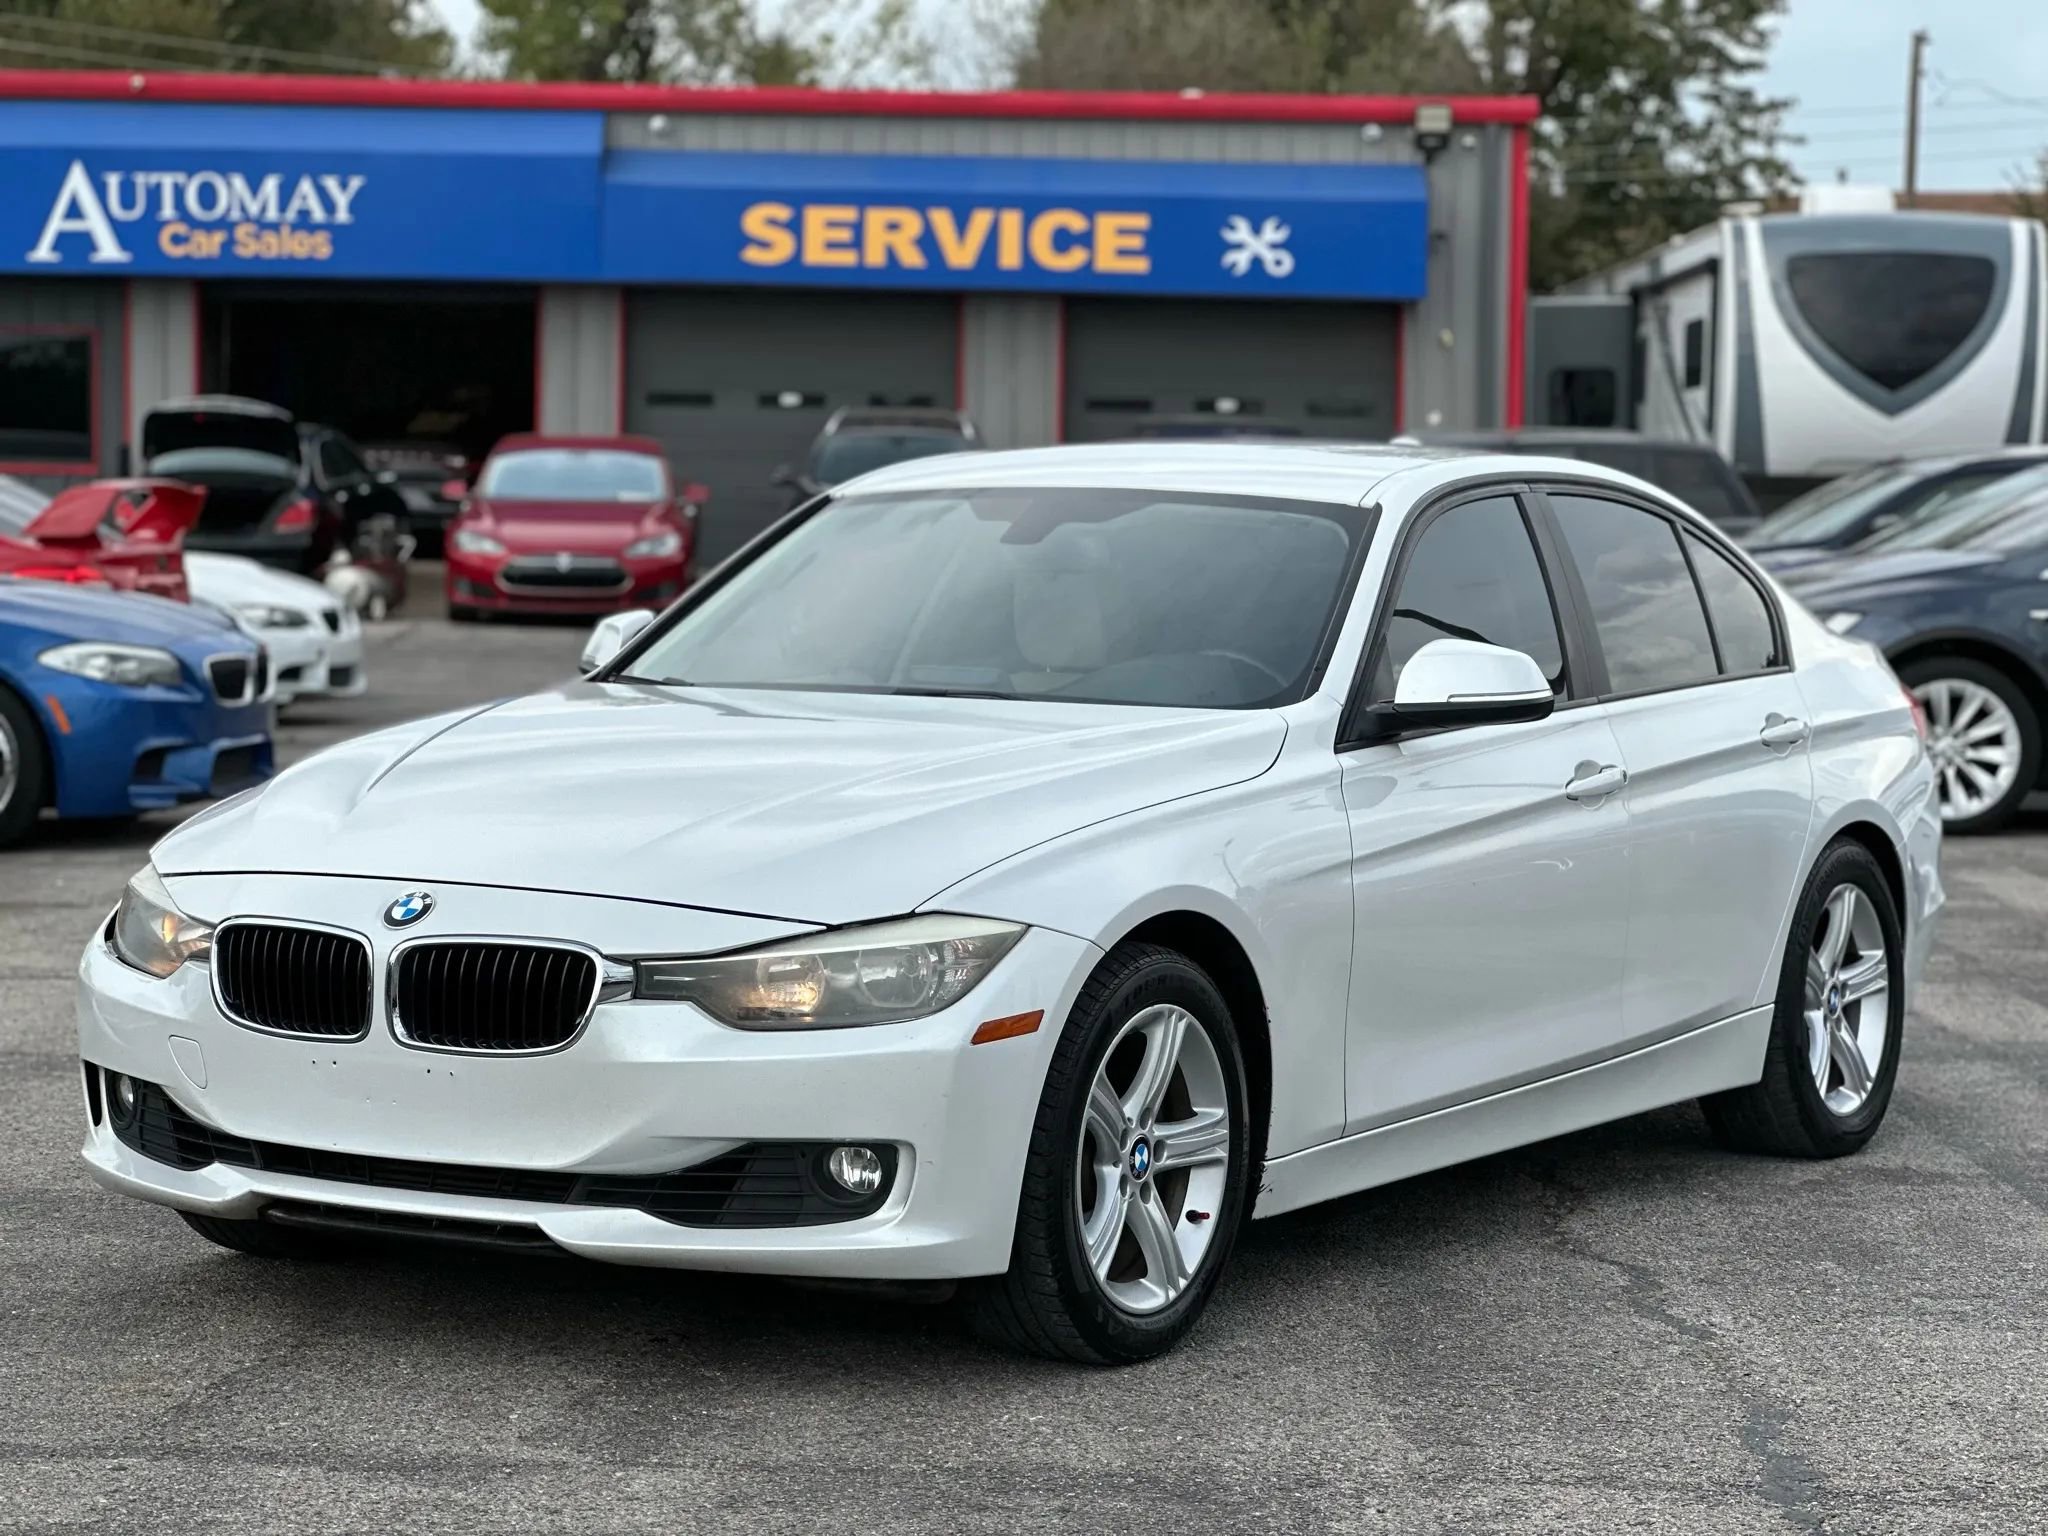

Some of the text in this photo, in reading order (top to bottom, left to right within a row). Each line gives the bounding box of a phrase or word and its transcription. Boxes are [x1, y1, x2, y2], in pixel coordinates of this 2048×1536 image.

[158, 220, 333, 260] Car Sales
[740, 202, 1151, 275] SERVICE
